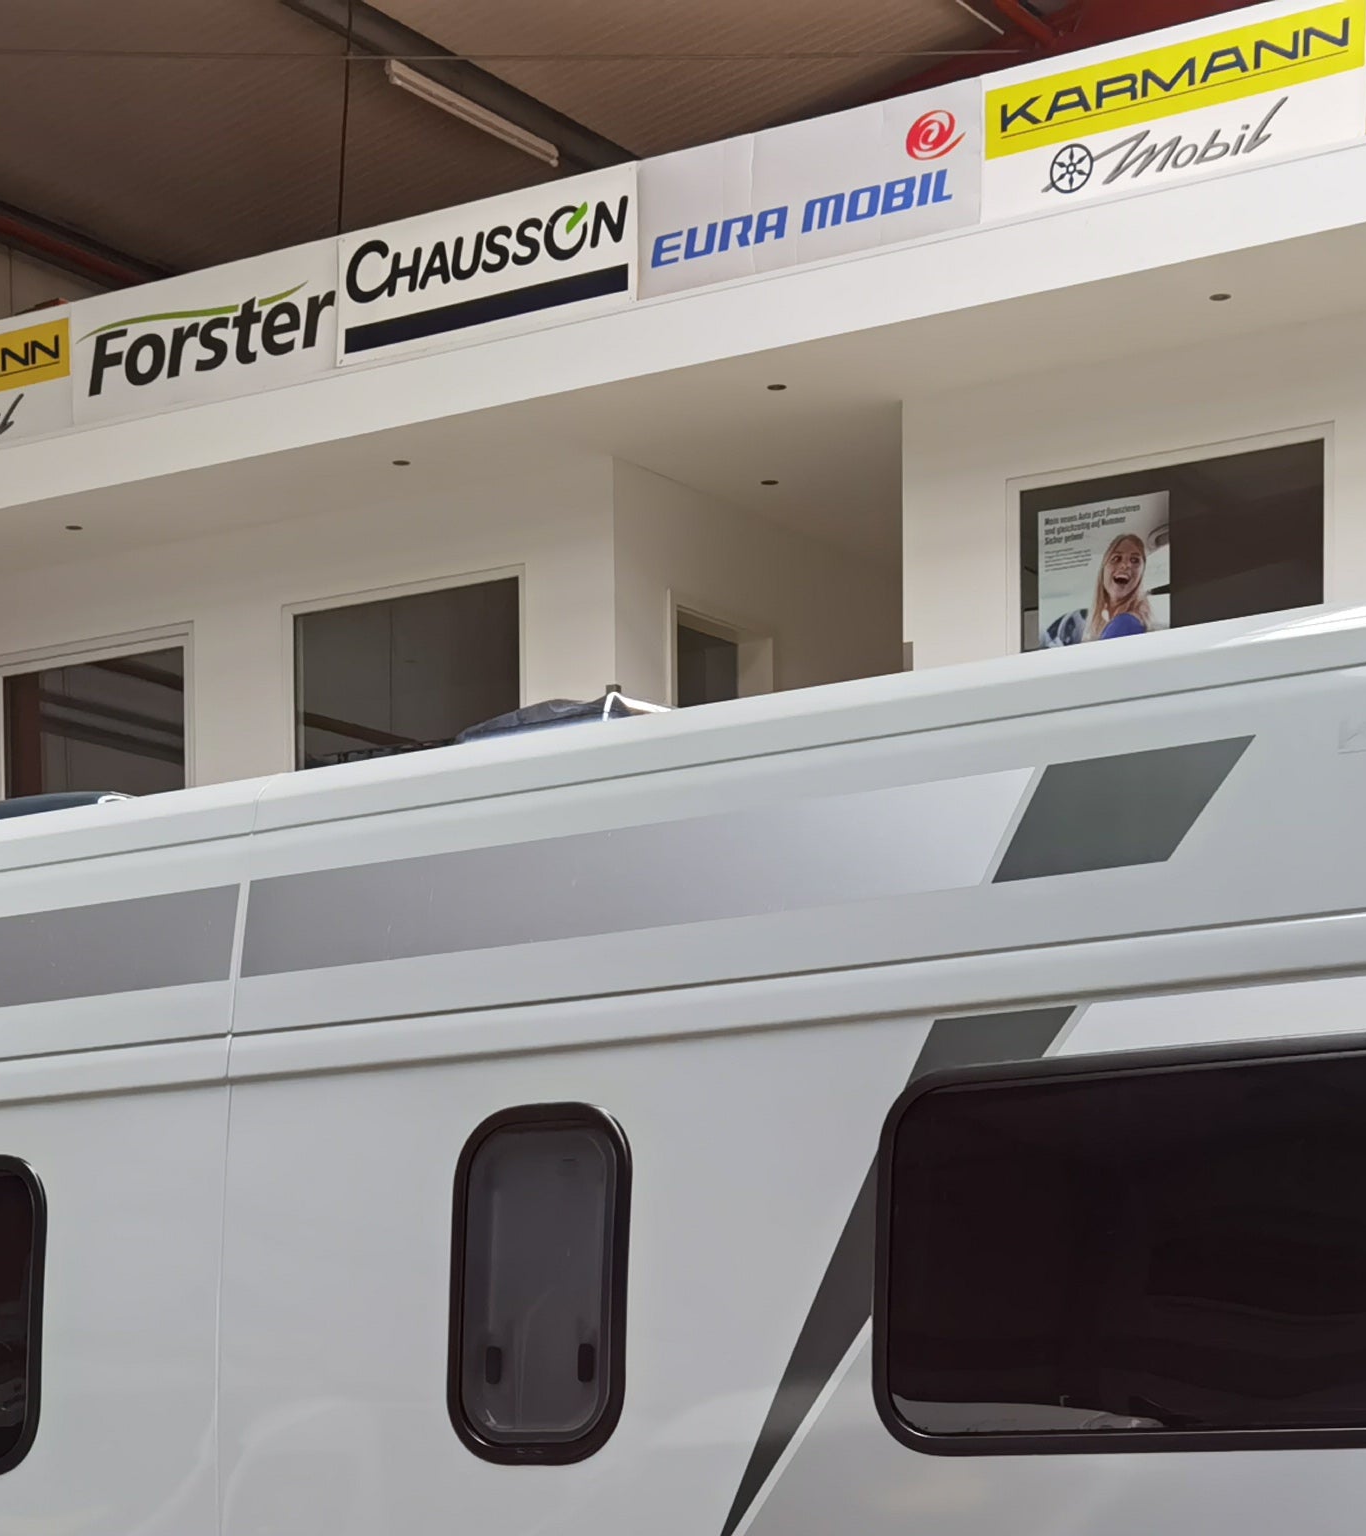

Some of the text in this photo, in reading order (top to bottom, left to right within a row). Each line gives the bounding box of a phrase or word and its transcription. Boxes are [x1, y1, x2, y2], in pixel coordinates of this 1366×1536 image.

[1001, 17, 1350, 133] KARMANN
[1093, 96, 1288, 185] Mobil
[650, 169, 953, 269] EURA MOBIL
[88, 288, 335, 398] Forster
